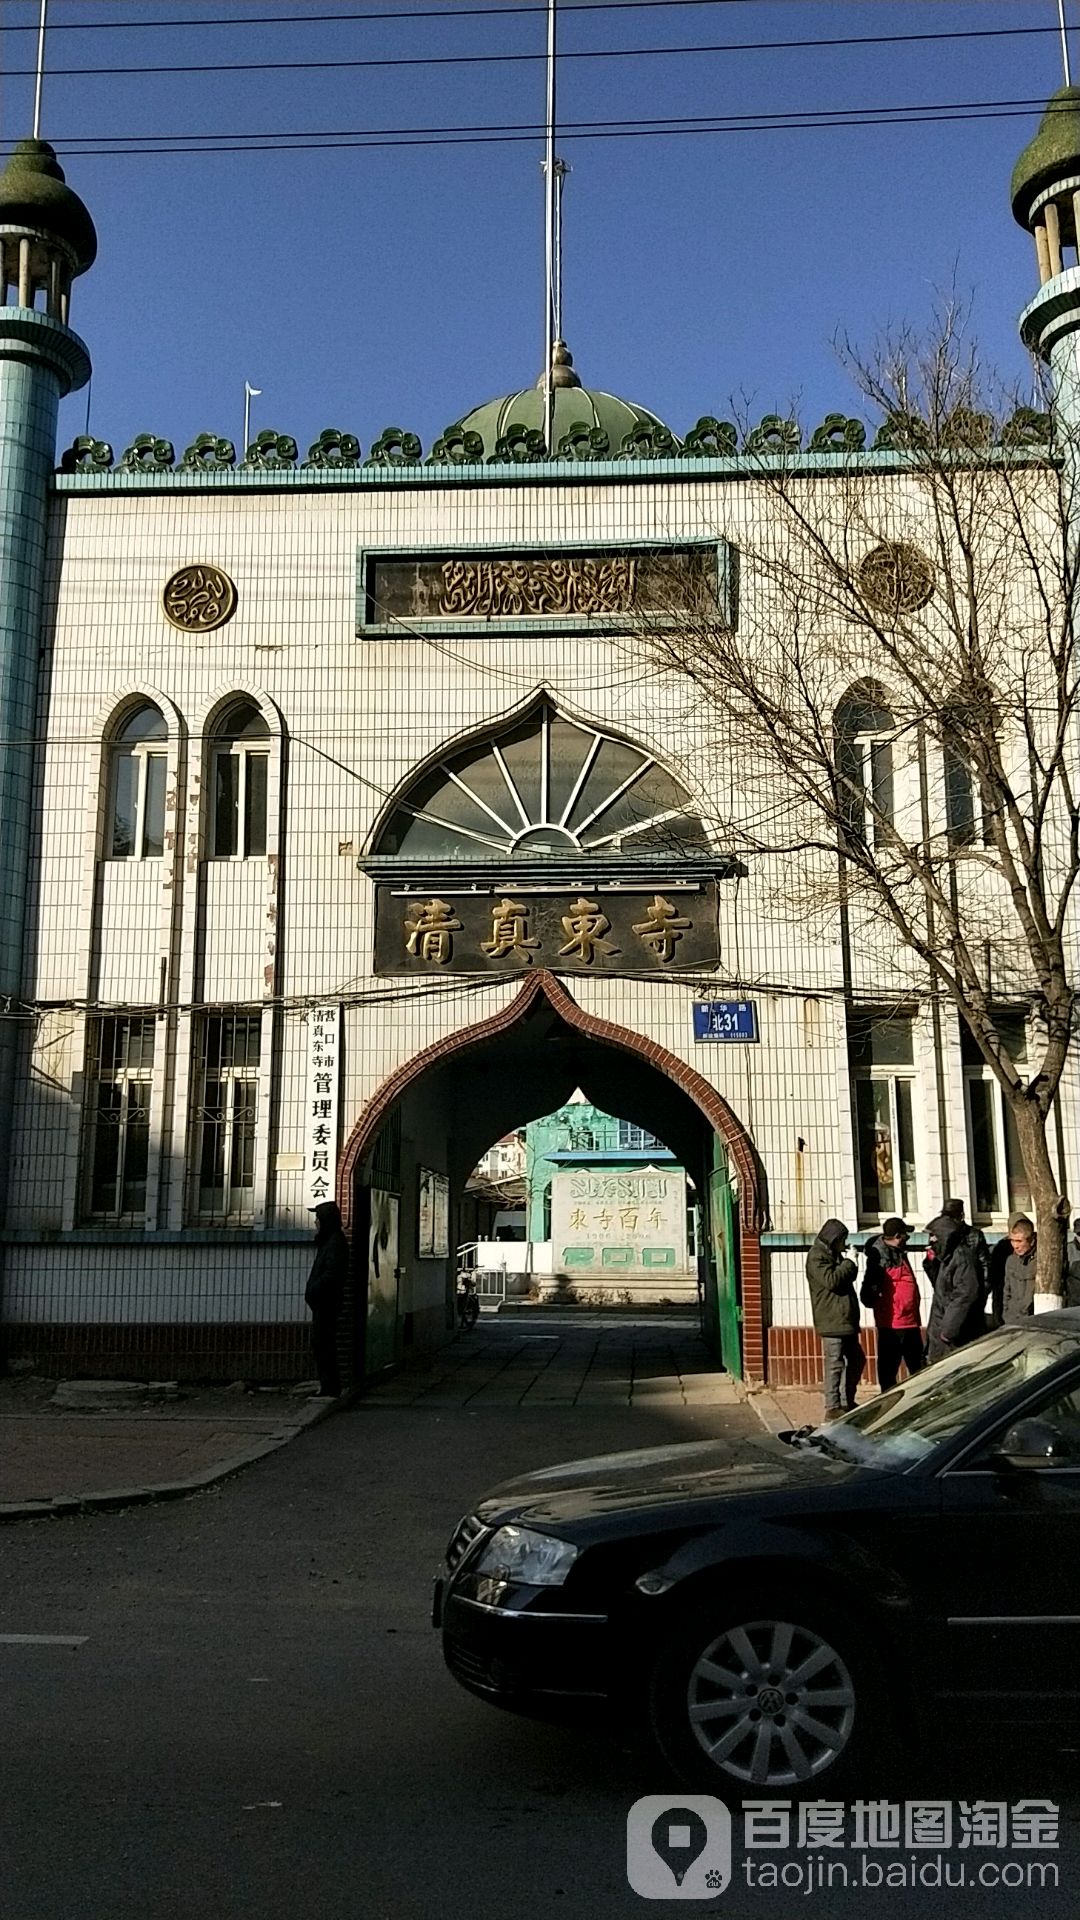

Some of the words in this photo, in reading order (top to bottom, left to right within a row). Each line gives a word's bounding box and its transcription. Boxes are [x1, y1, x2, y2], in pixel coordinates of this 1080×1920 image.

[404, 895, 692, 963] 清真東寺
[312, 1010, 323, 1067] 清真东寺
[324, 1010, 336, 1067] 营口市
[712, 1013, 739, 1031] 北31
[310, 1072, 332, 1198] 管理委员会
[569, 1206, 668, 1232] 東寺百年
